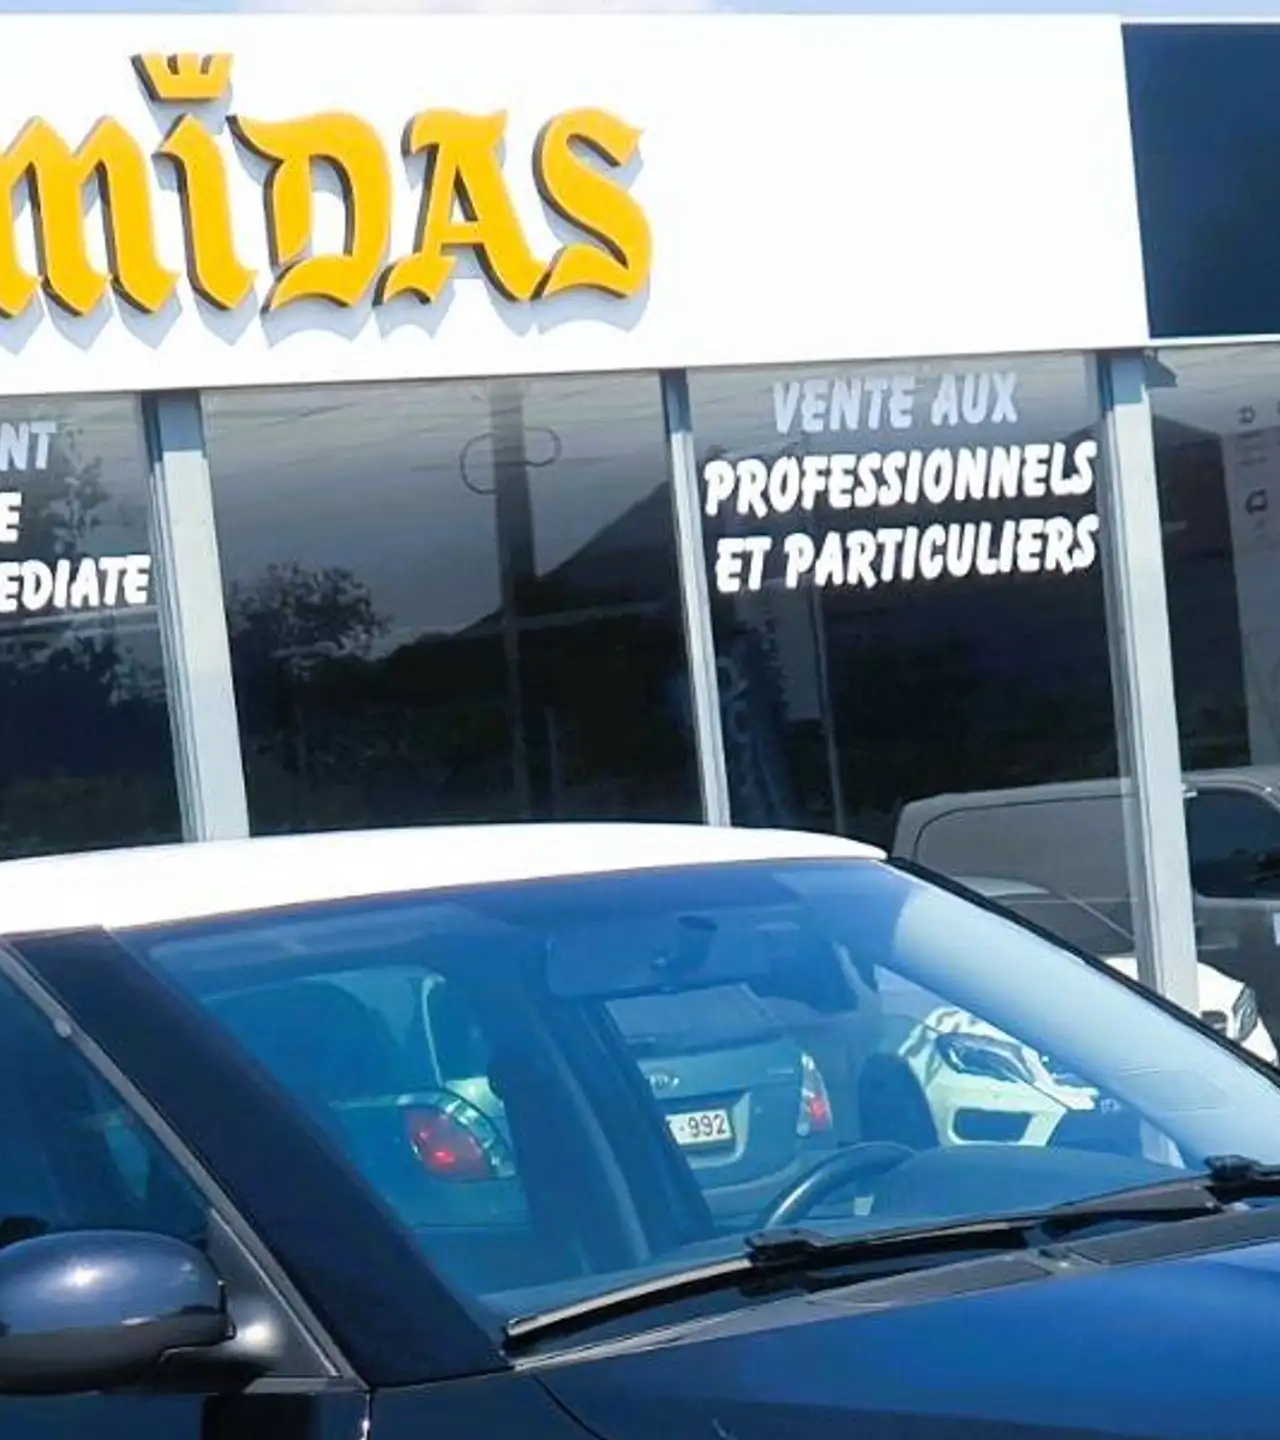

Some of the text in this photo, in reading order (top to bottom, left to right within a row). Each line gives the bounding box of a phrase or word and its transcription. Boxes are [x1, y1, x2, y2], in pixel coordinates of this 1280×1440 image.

[773, 371, 1019, 434] VENTE AUX
[702, 440, 1098, 518] PROFESSIONNELS
[714, 513, 1100, 594] ET PARTICULIERS
